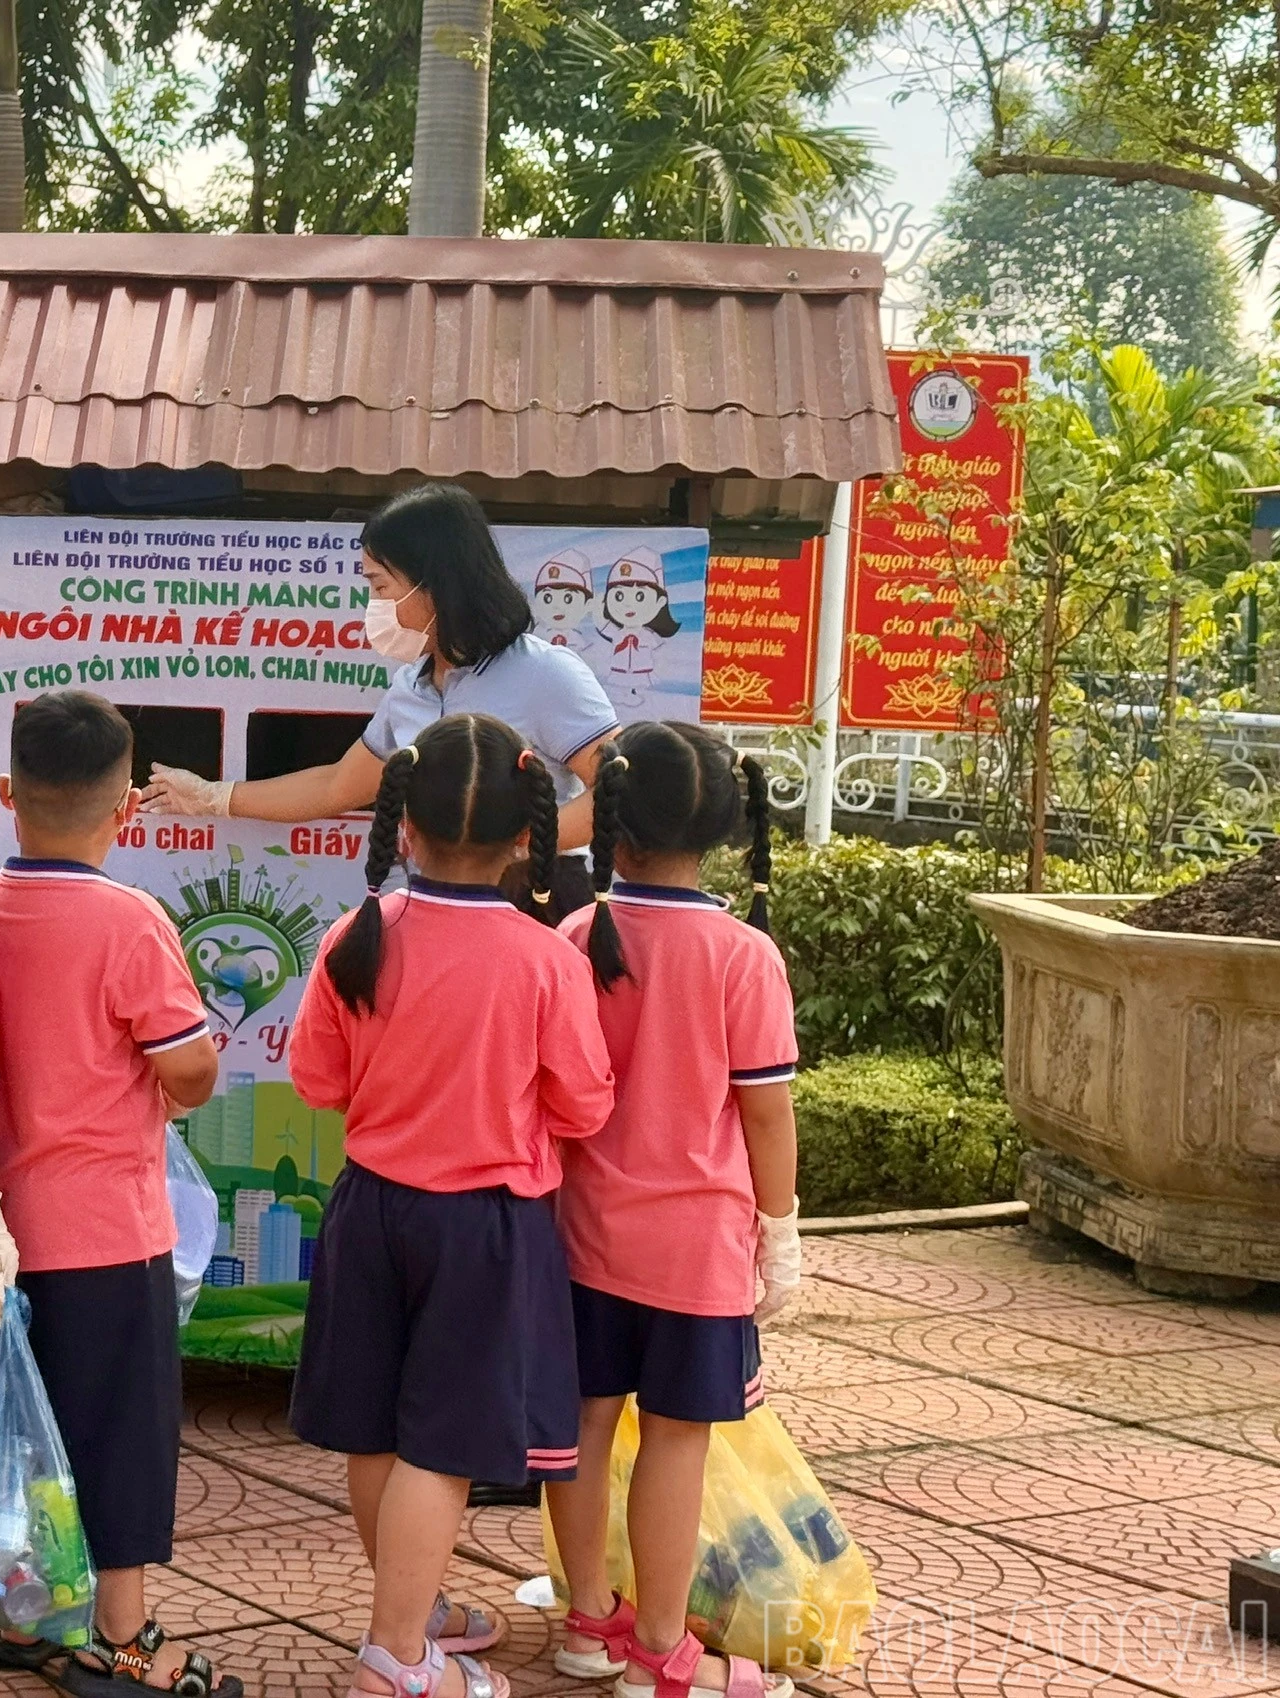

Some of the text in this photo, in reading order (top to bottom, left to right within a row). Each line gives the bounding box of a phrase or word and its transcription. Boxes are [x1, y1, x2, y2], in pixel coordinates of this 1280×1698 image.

[959, 455, 1002, 480] giáo
[64, 529, 103, 545] LIÊN
[108, 530, 138, 548] ĐỘI
[144, 531, 215, 548] TRƯỜNG
[221, 529, 260, 549] TIỂU
[265, 537, 302, 552] HỌC
[307, 533, 344, 551] BẮC
[13, 550, 59, 568] LIÊN
[65, 551, 100, 572] ĐỘI
[107, 553, 191, 572] TRƯỜNG
[197, 551, 243, 573] TIỂU
[249, 558, 292, 576] HỌC
[299, 555, 328, 575] SỐ
[335, 560, 344, 575] 1
[869, 553, 915, 573] ngọn
[60, 575, 145, 603] CÔNG
[153, 578, 242, 606] TRÌNH
[247, 583, 341, 610] MĂNG
[100, 609, 184, 645] NHÀ
[194, 606, 250, 647] KẾ
[252, 618, 372, 656] HOẠC
[23, 662, 73, 689] CHO
[77, 654, 114, 683] TÔI
[120, 655, 161, 680] XIN
[168, 648, 200, 678] VỎ
[205, 654, 256, 681] LON,
[261, 655, 318, 683] CHAI
[878, 647, 931, 672] người
[290, 823, 363, 861] Giấy
